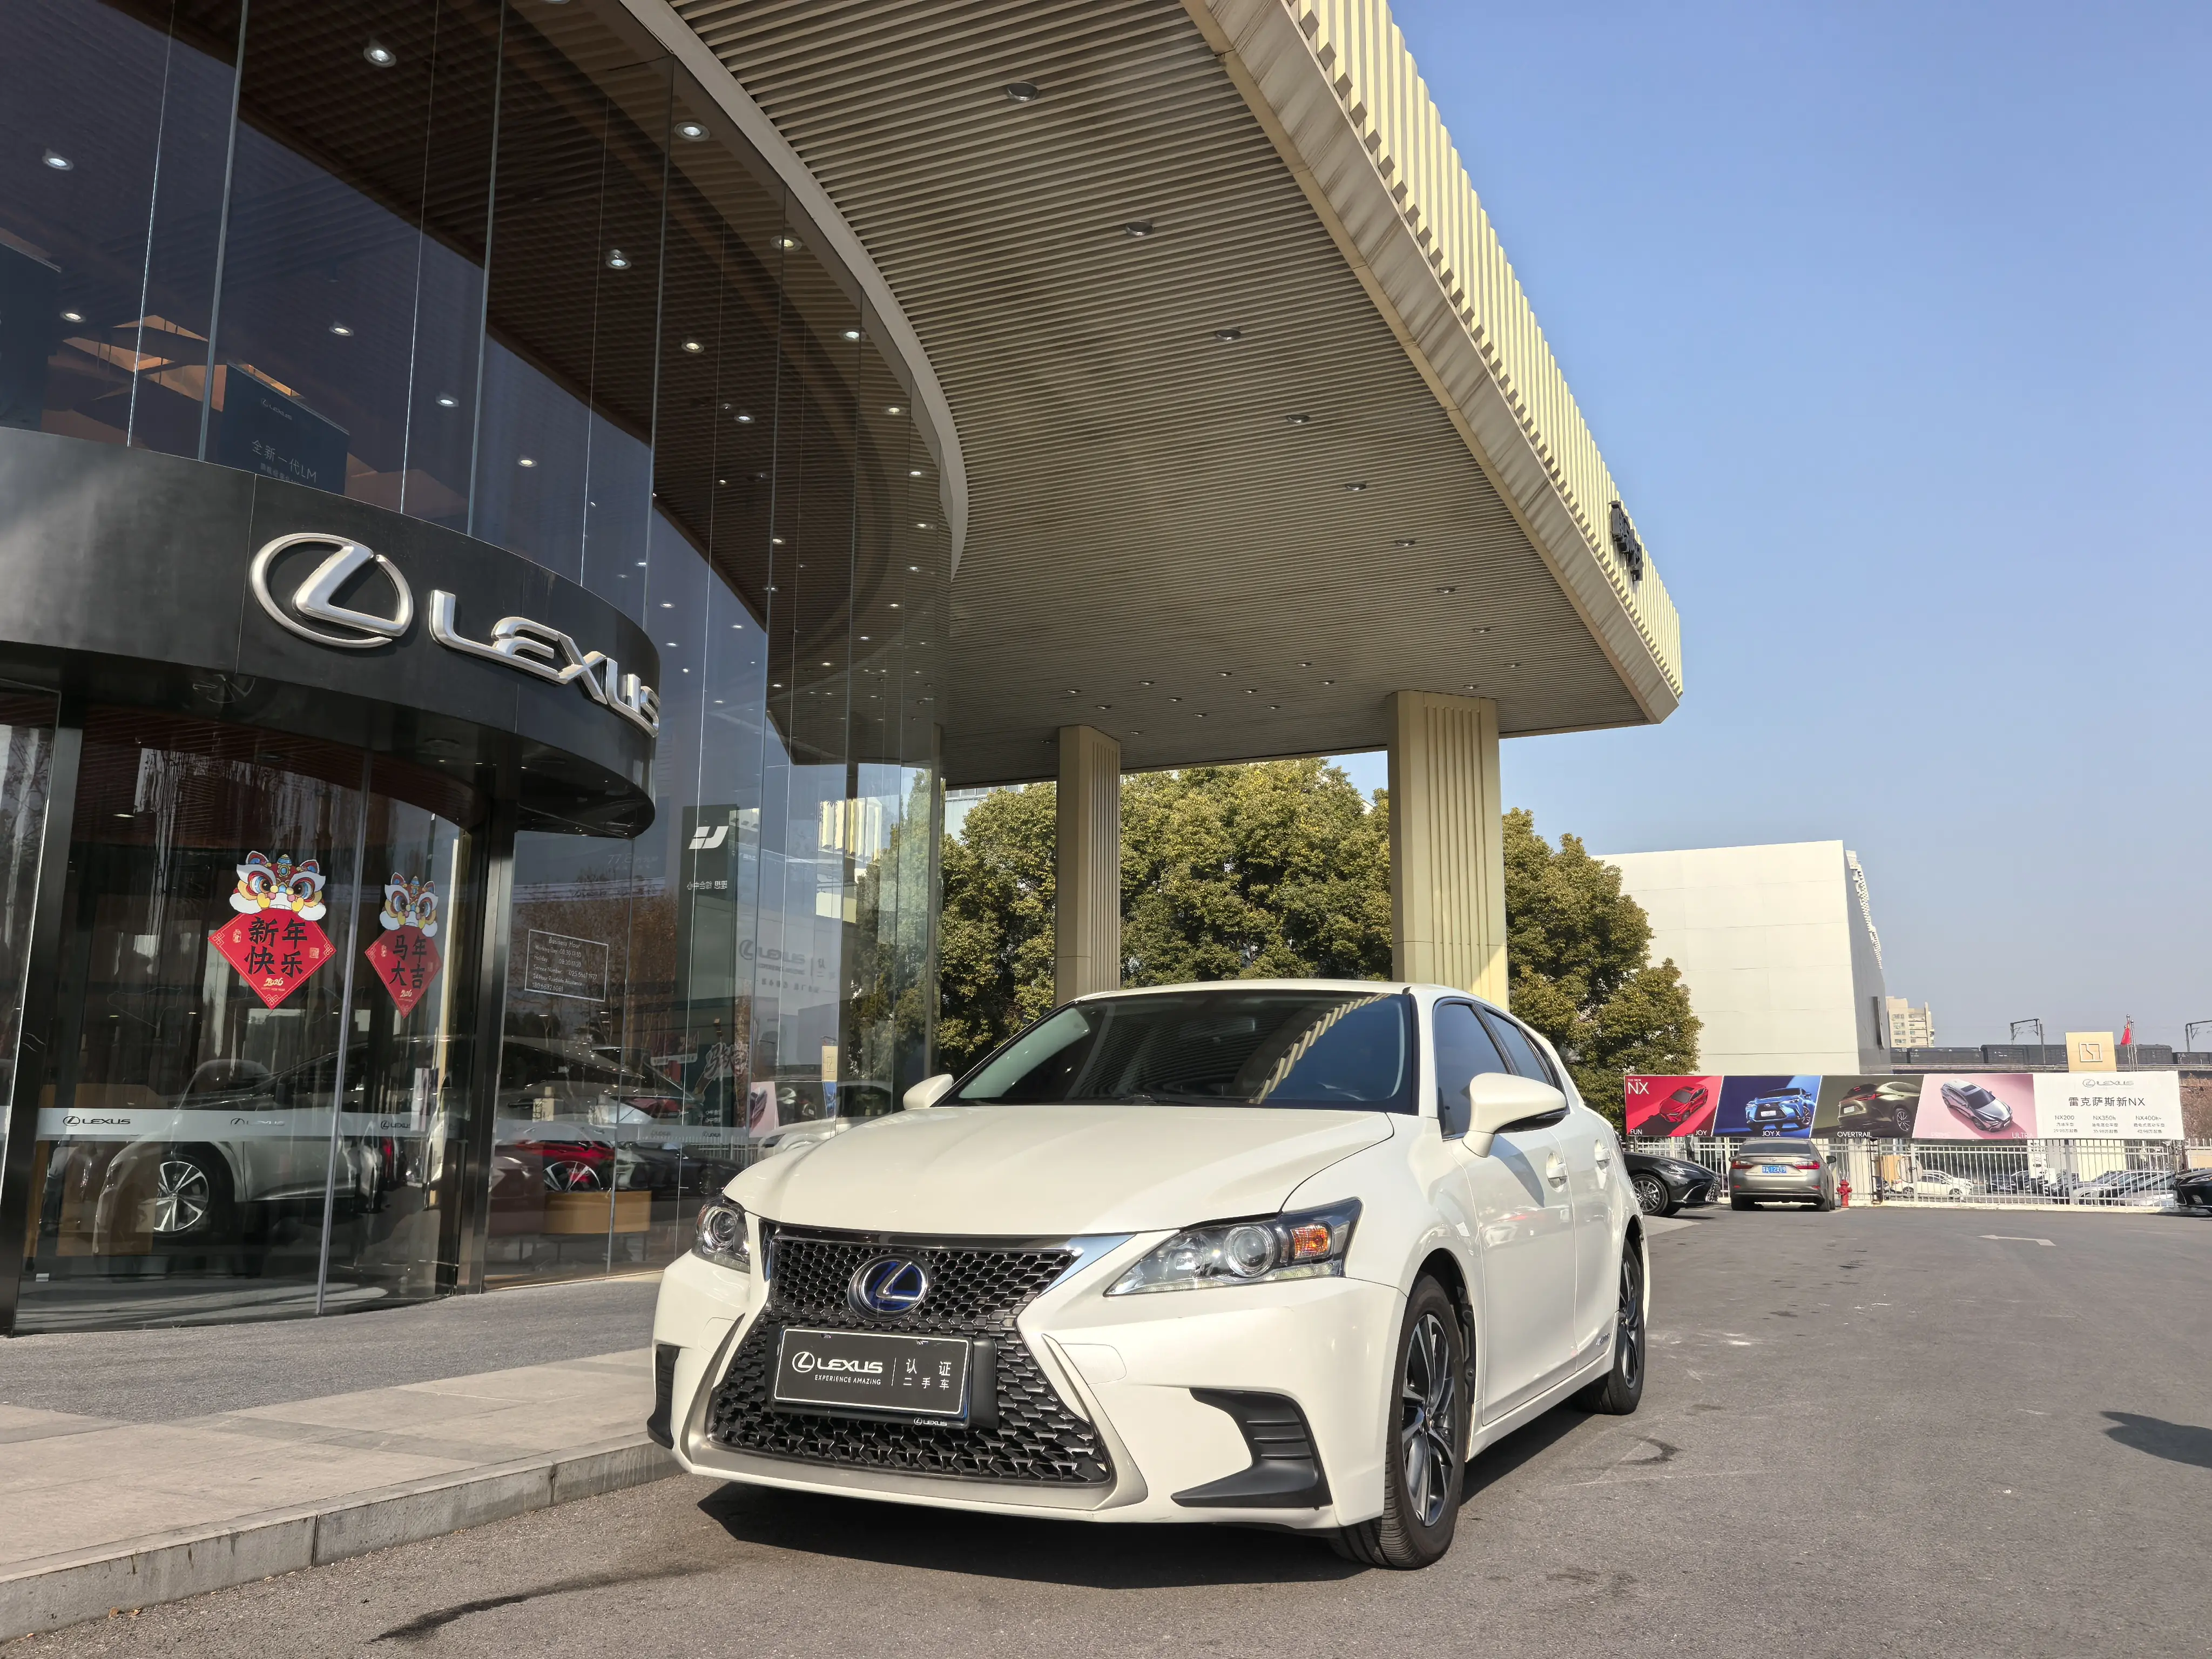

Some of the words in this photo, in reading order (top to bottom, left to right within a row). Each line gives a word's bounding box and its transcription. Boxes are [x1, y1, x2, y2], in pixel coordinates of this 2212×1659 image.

[252, 440, 316, 483] 全新一代LM
[429, 589, 660, 738] LEXUS
[248, 916, 307, 949] 新年
[393, 934, 427, 963] 马年
[244, 946, 303, 978] 快乐
[264, 977, 284, 986] 2026
[389, 960, 425, 989] 大吉
[1628, 1082, 1649, 1095] NX
[2068, 1097, 2146, 1107] 雷克萨斯新NX
[817, 1358, 883, 1373] LEXUS
[906, 1358, 952, 1376] 认证
[815, 1374, 851, 1383] EXPERIENCE
[853, 1377, 881, 1385] AMAZING
[903, 1377, 949, 1391] 二手车
